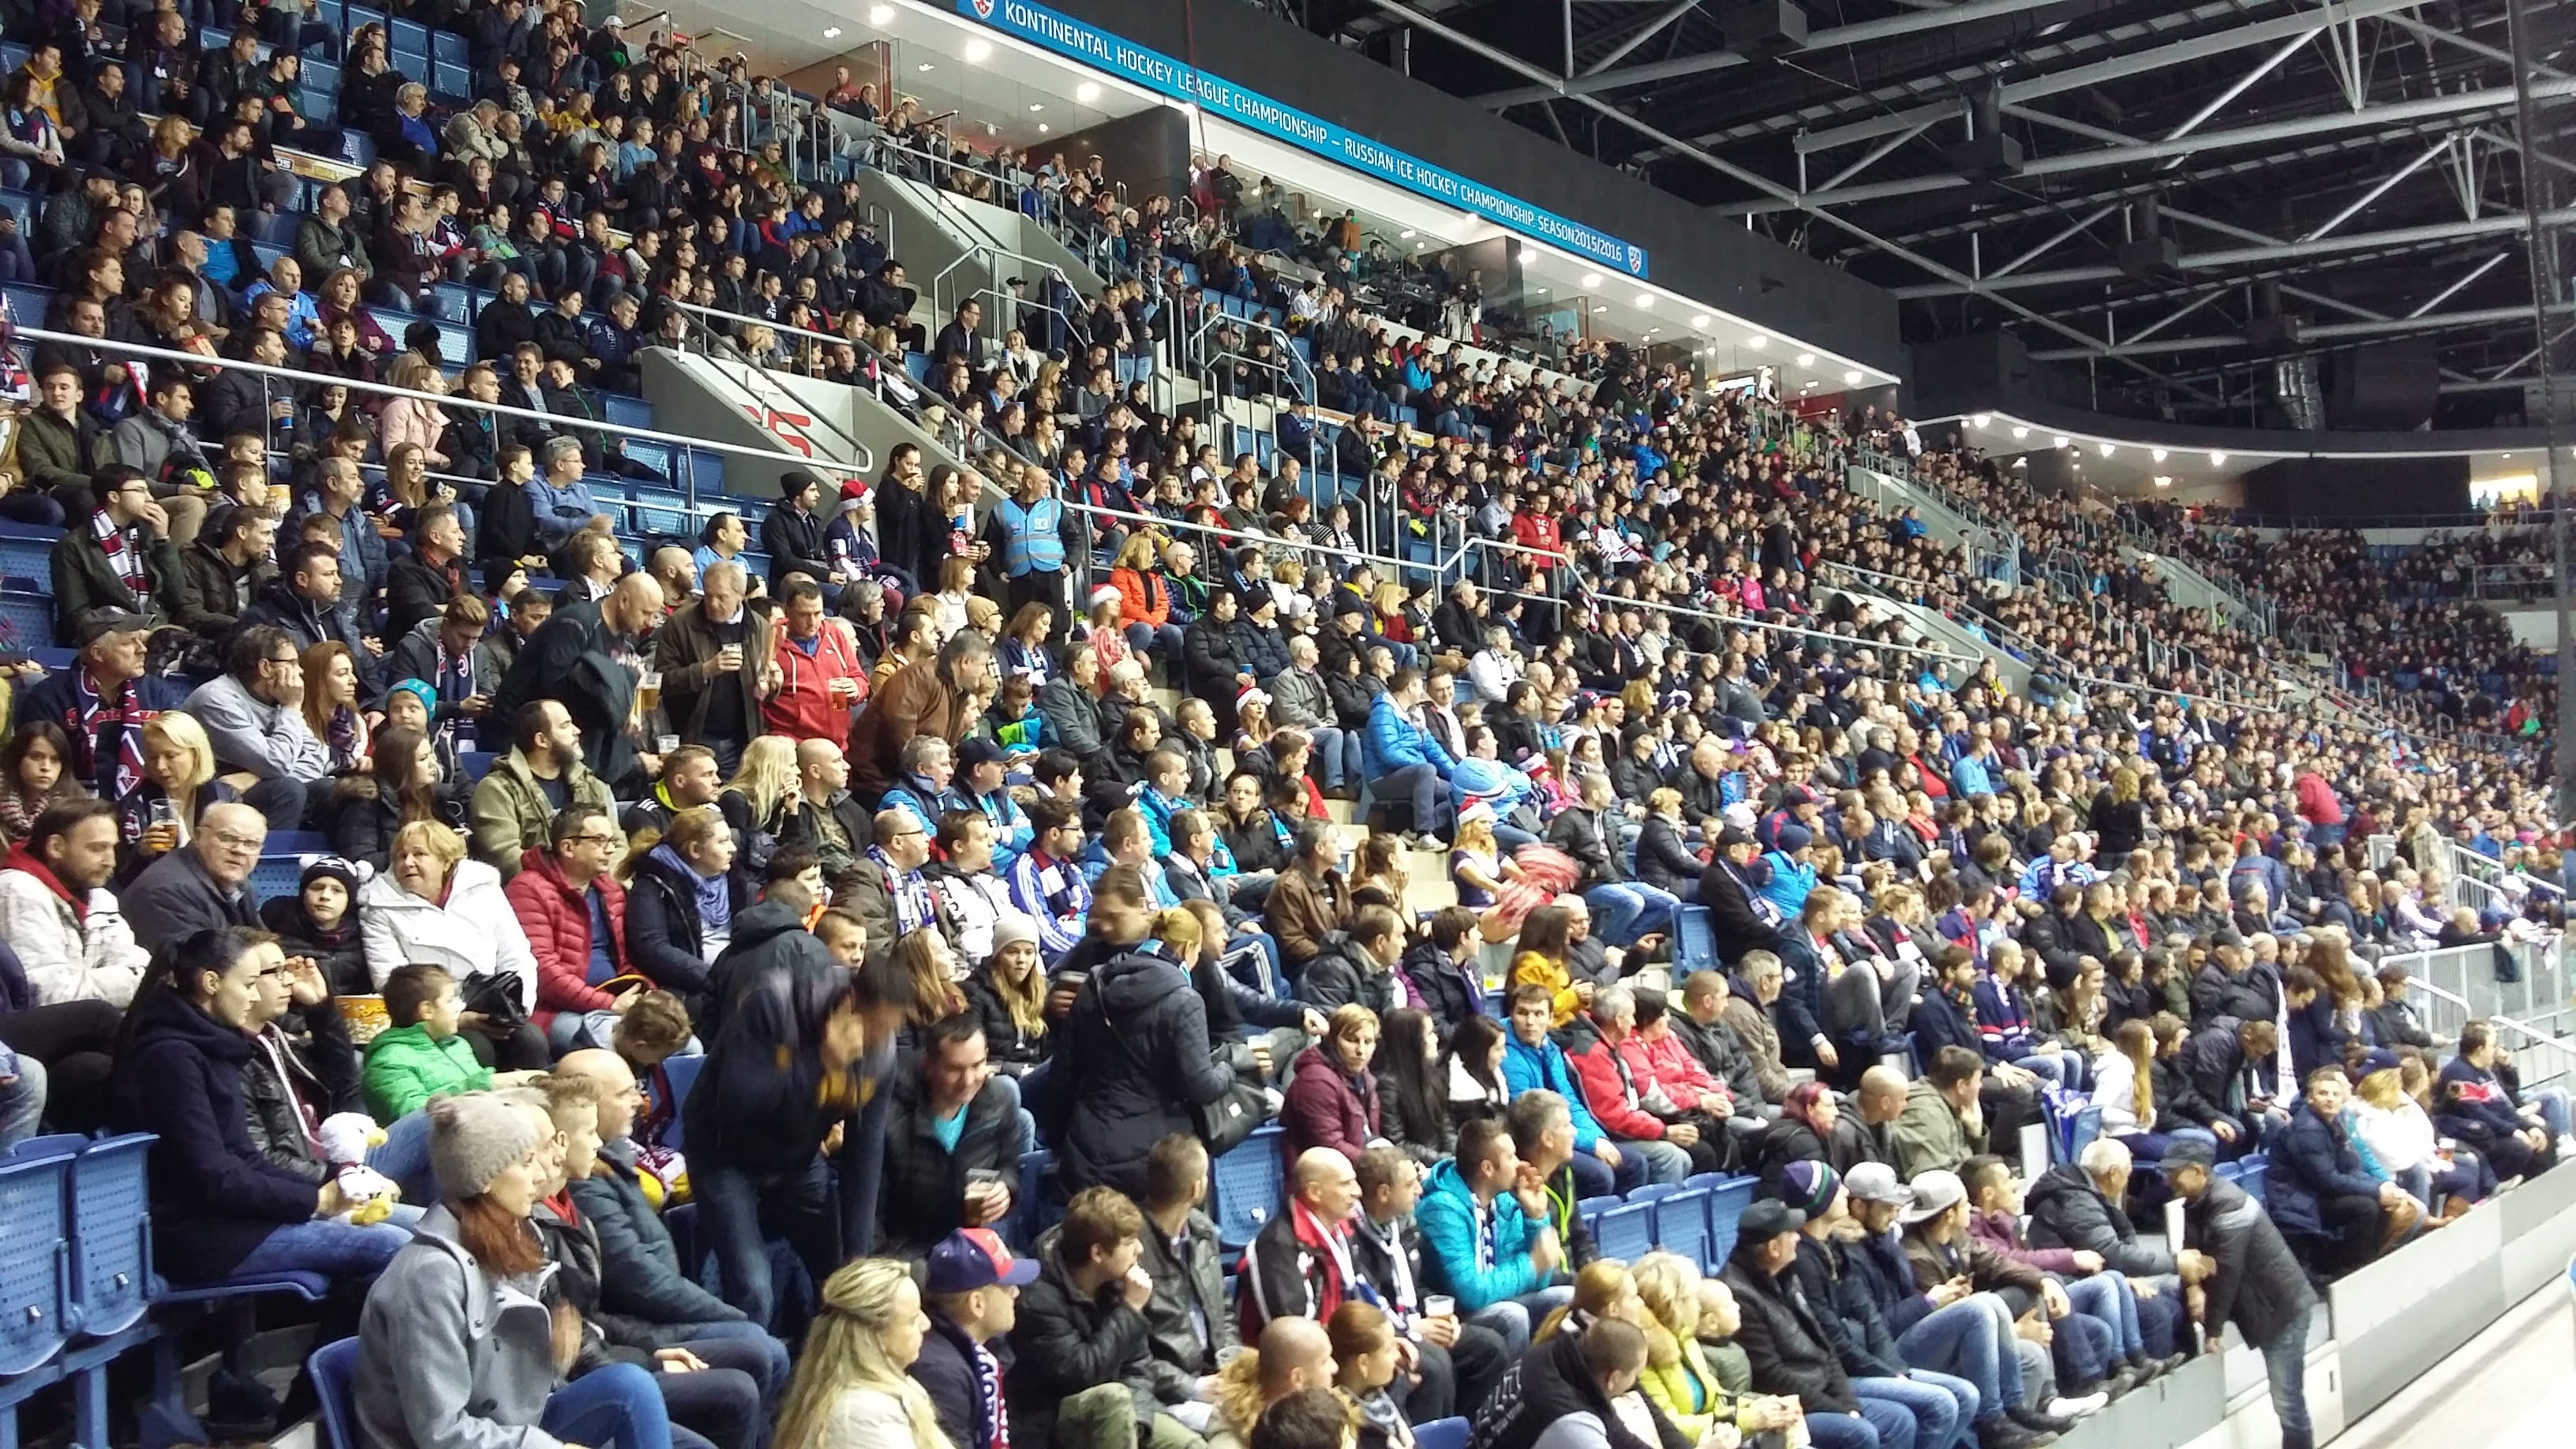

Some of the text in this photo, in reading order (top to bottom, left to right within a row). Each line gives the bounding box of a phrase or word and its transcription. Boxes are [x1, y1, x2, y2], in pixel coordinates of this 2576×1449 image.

[1005, 0, 1113, 62] KONTINENTAL
[1117, 46, 1174, 84] HOCKEY
[1178, 69, 1230, 108] LEAGUE
[1234, 93, 1327, 144] CHAMPIONSHIP
[1344, 137, 1394, 173] RUSSIAN
[1396, 159, 1414, 181] ICE
[1416, 167, 1458, 197] HOCKEY
